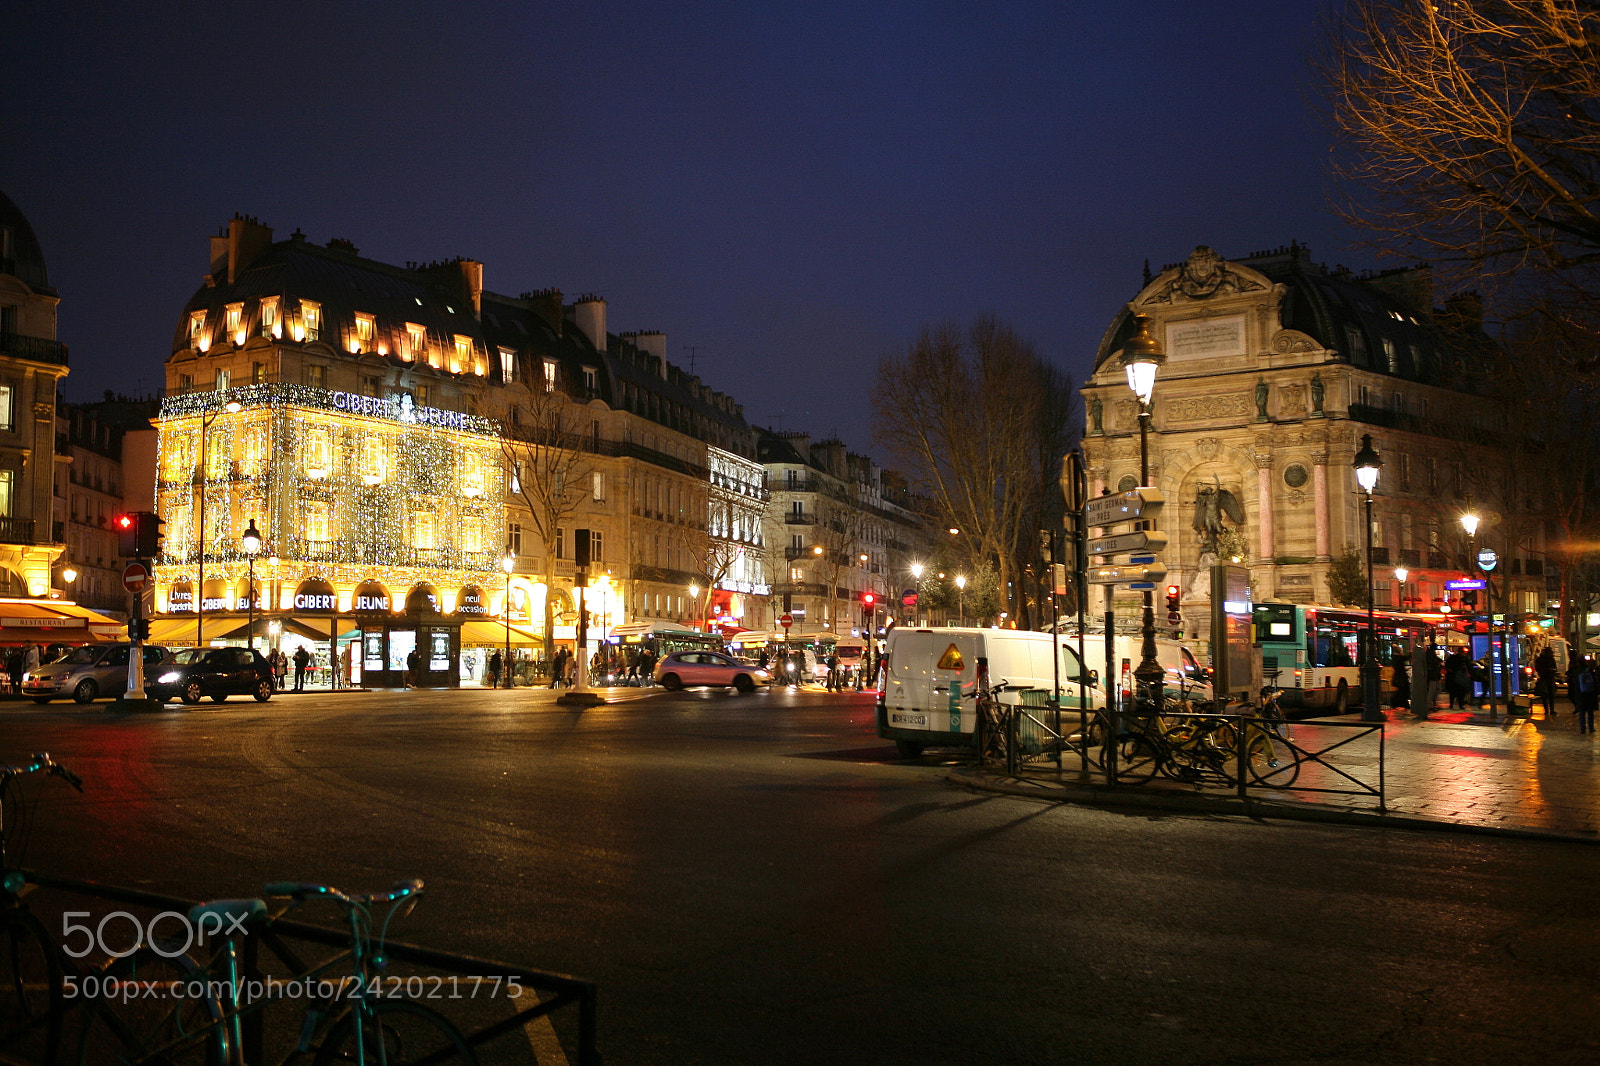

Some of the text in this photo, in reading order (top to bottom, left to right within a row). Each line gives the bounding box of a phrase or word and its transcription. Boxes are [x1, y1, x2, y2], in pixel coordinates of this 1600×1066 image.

[332, 391, 468, 429] GIBERT JEUNE
[1479, 553, 1496, 561] BUS
[170, 589, 192, 600] Livres
[236, 598, 261, 609] JEUE
[294, 593, 389, 610] GIBERT JEUNE
[458, 605, 487, 613] occasion
